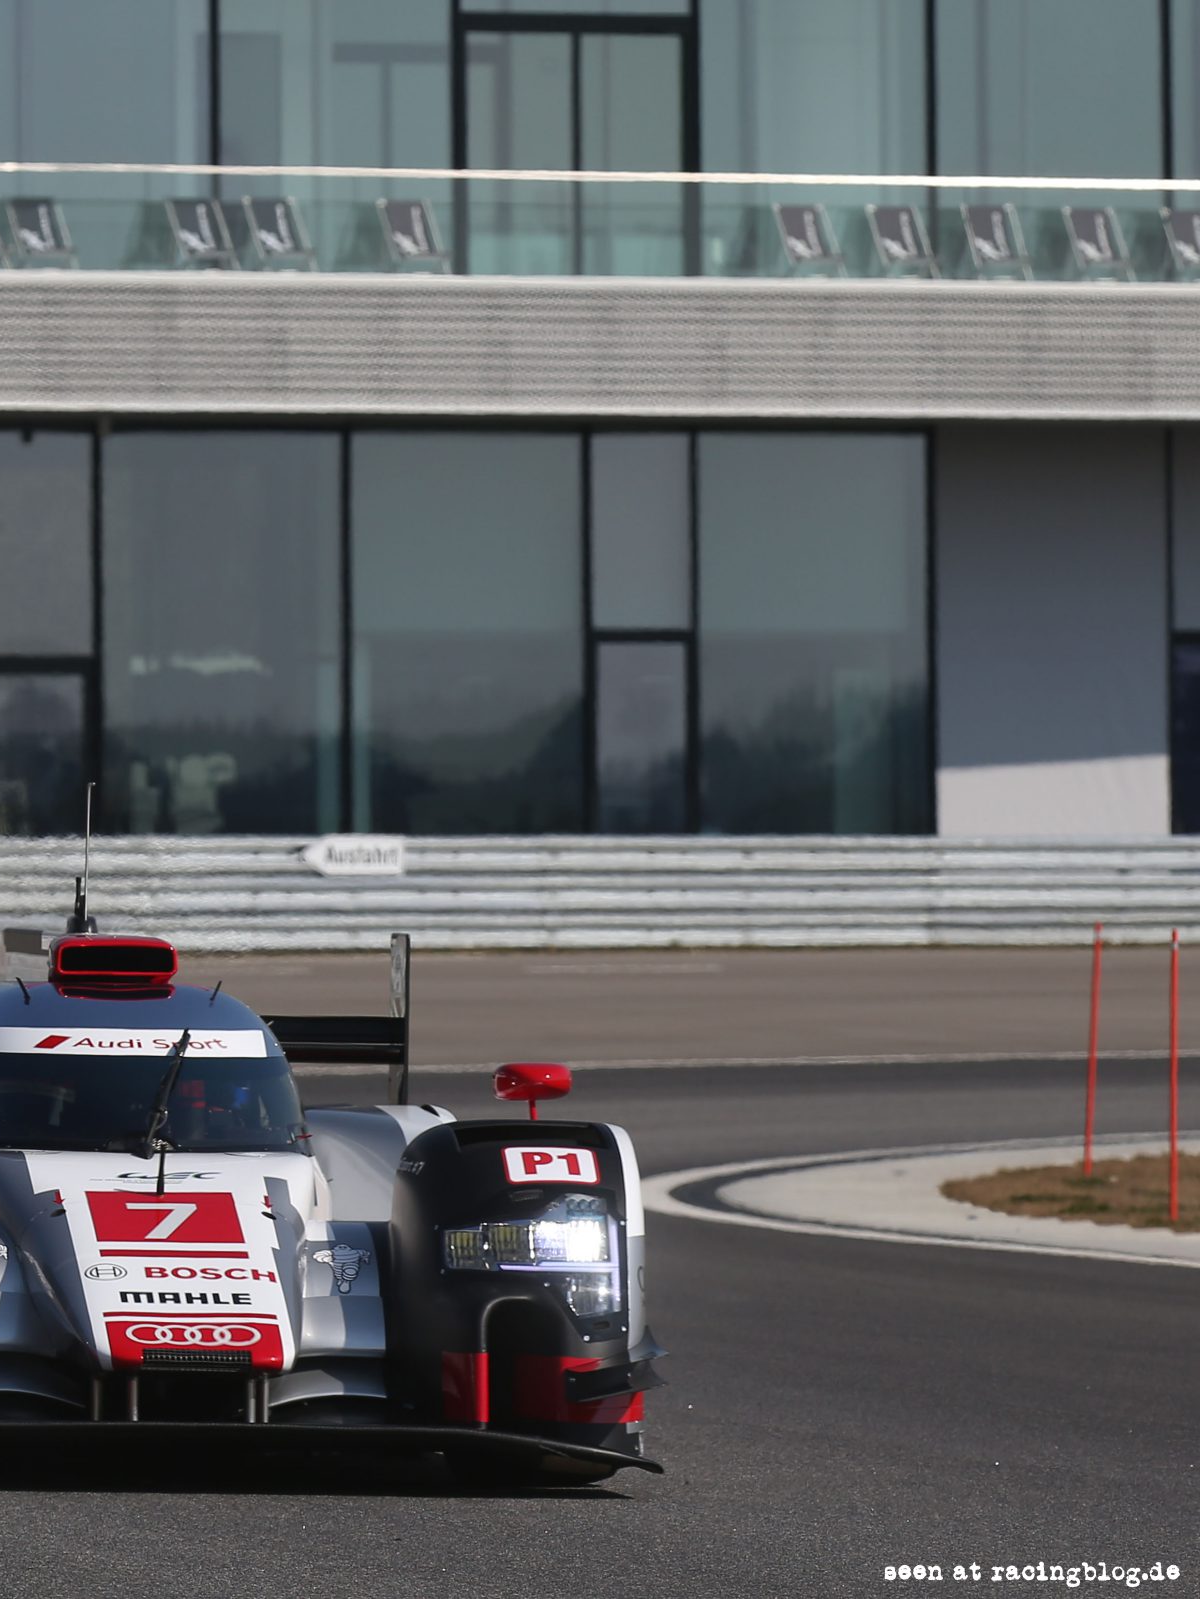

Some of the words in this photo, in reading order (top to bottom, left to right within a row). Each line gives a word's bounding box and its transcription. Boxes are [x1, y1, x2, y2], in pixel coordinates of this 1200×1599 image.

[73, 1037, 143, 1049] Audi
[153, 1038, 228, 1050] Sort
[521, 1152, 581, 1176] P1
[125, 1203, 197, 1239] 7
[144, 1266, 277, 1283] BOSCH
[119, 1291, 252, 1305] MAHLE
